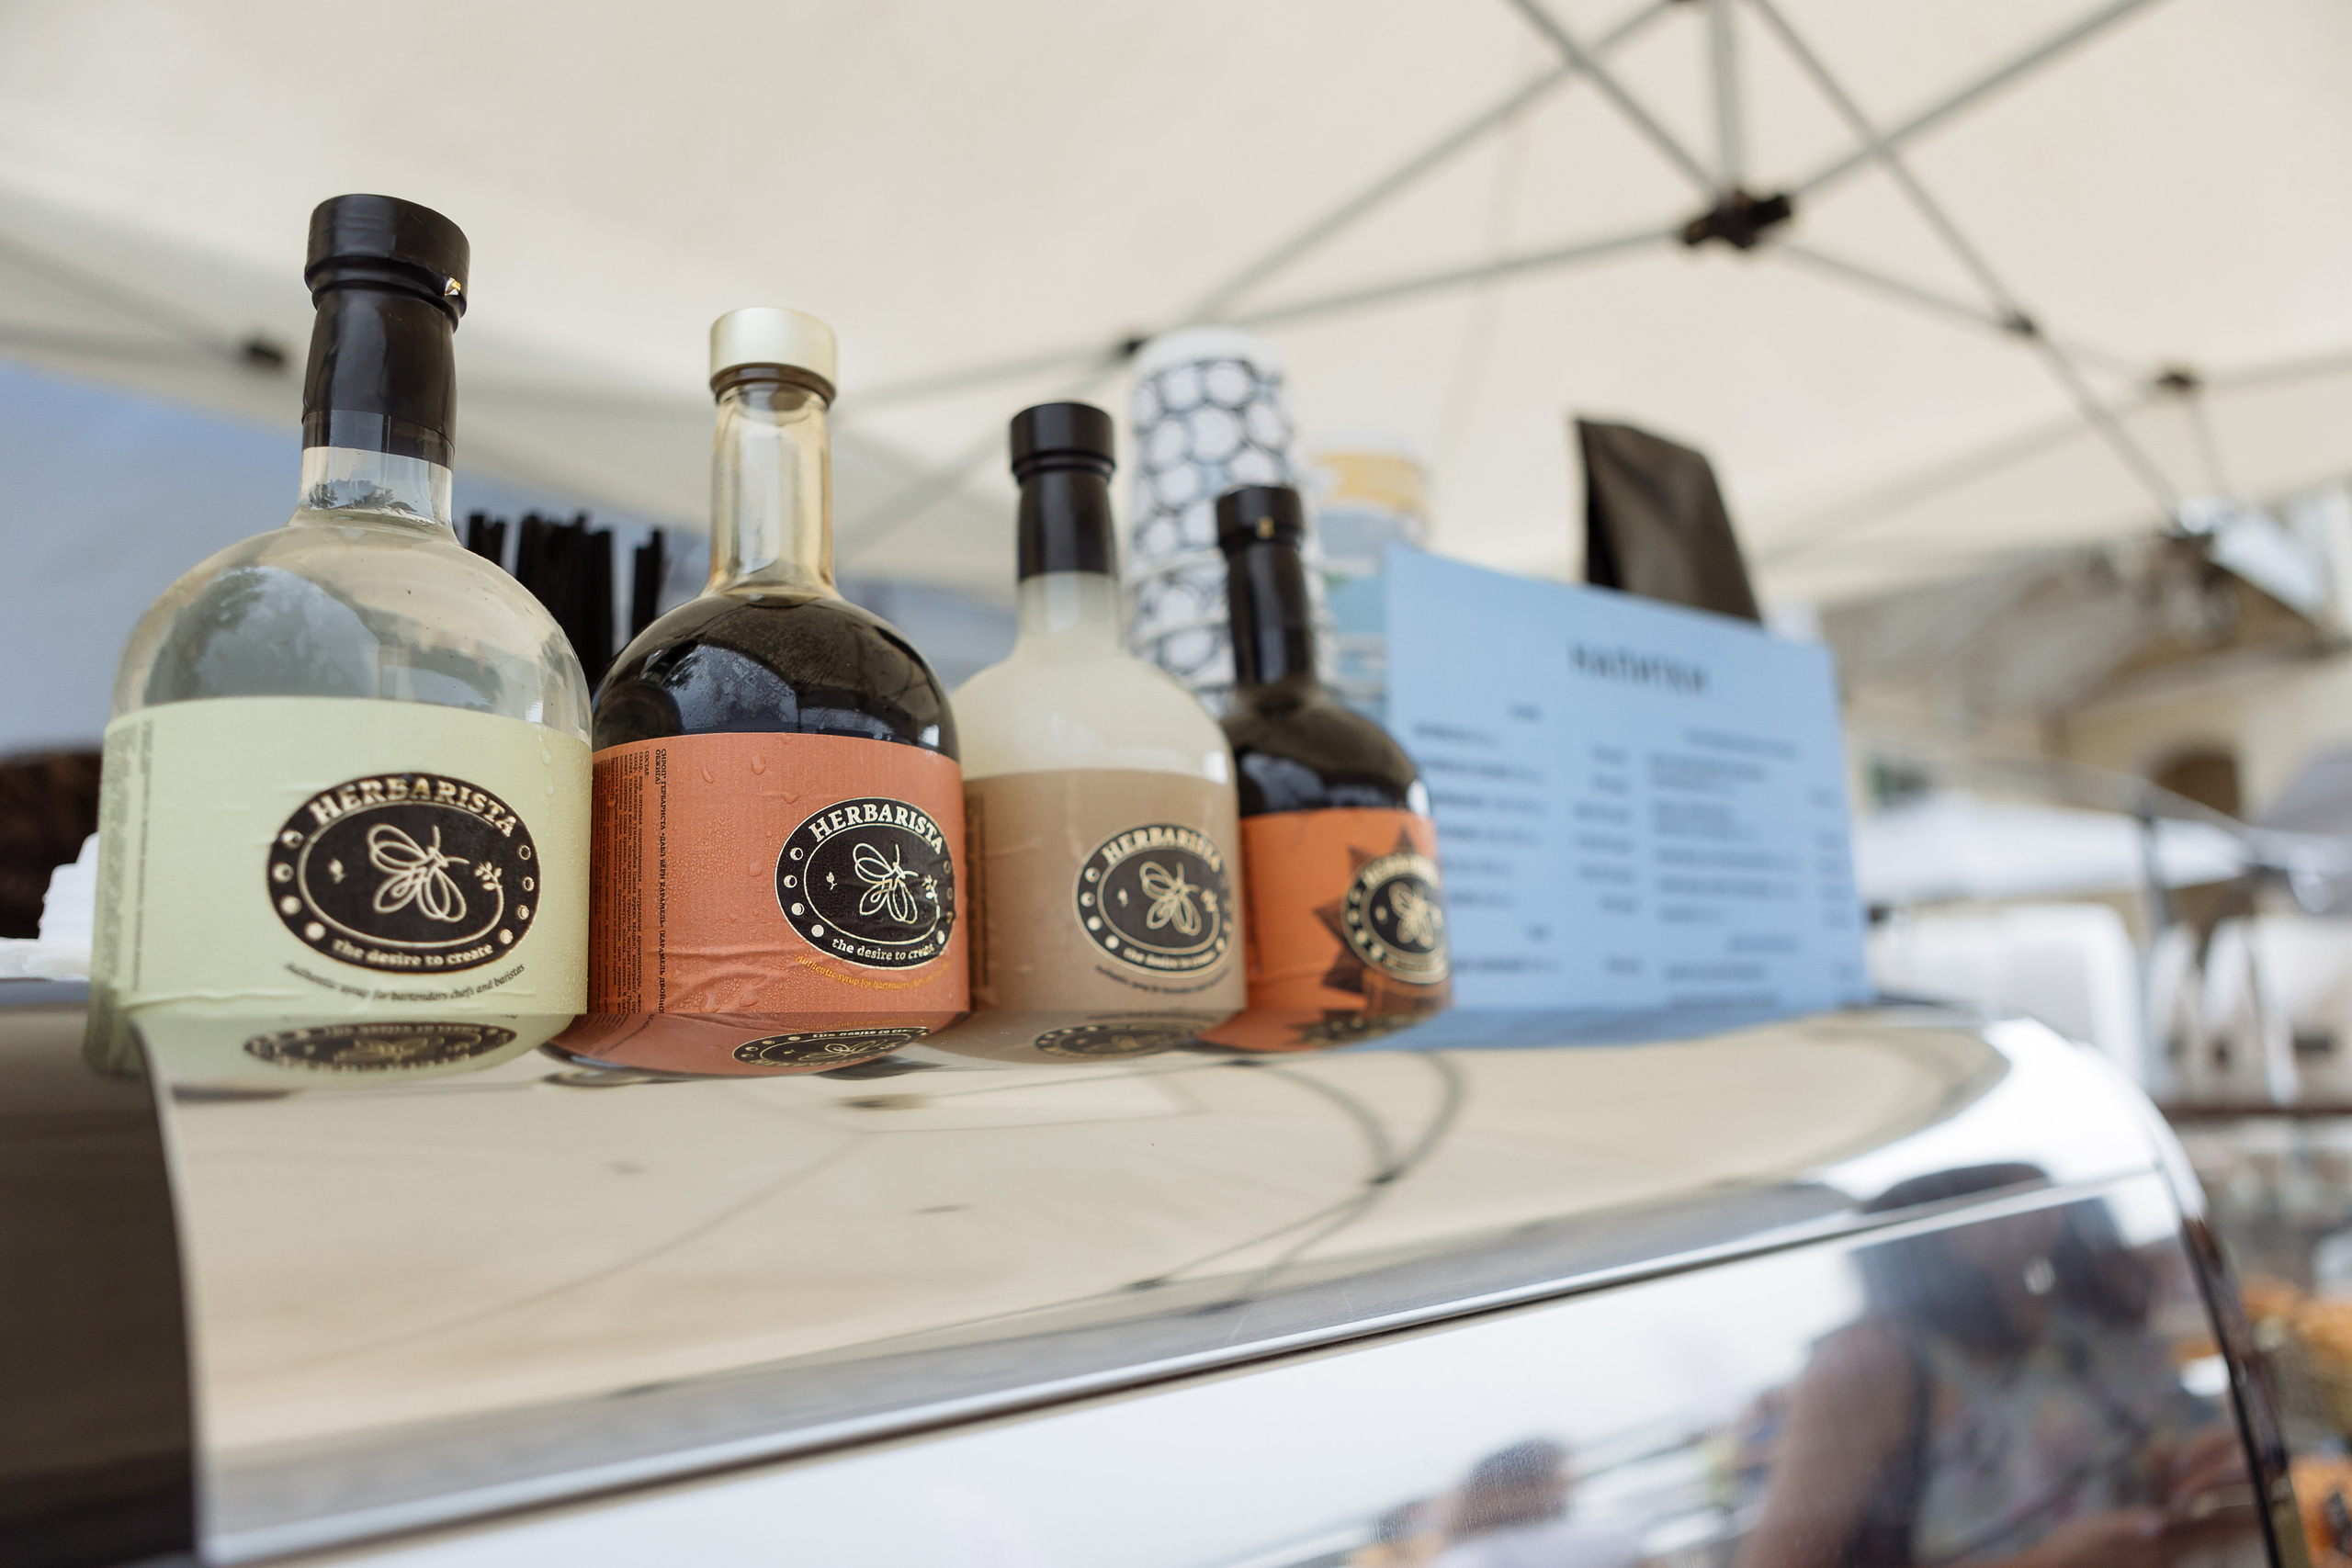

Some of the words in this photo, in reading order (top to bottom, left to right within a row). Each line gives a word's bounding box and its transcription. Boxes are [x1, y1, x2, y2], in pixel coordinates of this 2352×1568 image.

[308, 778, 517, 837] HERBARISTA
[808, 803, 944, 855] HERBARISTA
[332, 938, 364, 959] the
[368, 947, 422, 966] desire
[424, 954, 444, 965] to
[447, 943, 494, 964] create
[831, 938, 854, 953] the
[856, 945, 892, 961] desire
[895, 951, 906, 960] to
[390, 990, 447, 1001] bartenders
[450, 986, 475, 999] chefs
[476, 979, 493, 994] and
[493, 964, 525, 988] baristas
[795, 954, 836, 979] Authentic
[837, 973, 860, 987] syrup
[860, 978, 872, 989] for
